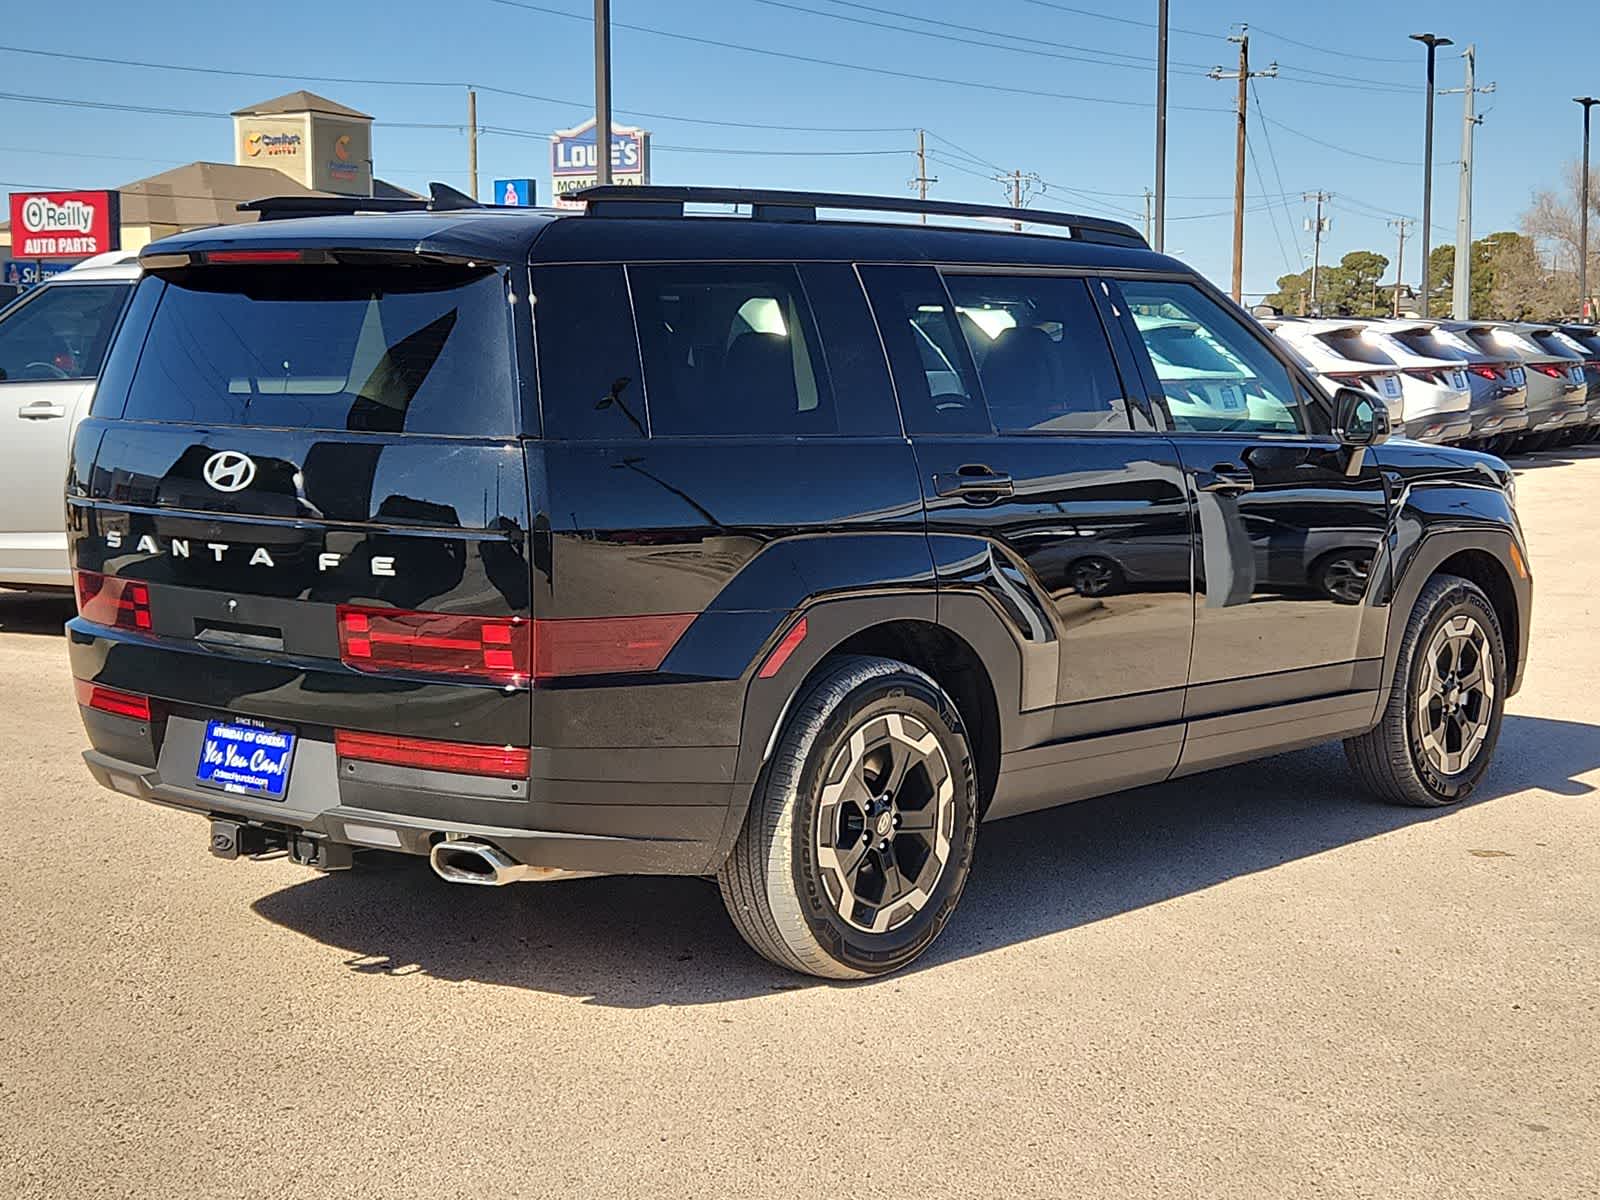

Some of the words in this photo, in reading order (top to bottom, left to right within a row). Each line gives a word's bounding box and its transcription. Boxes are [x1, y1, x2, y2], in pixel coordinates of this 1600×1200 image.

[24, 200, 92, 231] O'Reilly
[24, 238, 56, 254] AUTO
[57, 237, 97, 253] PARTS
[105, 529, 276, 568] SANTA
[319, 552, 397, 577] FE
[204, 740, 223, 765] Yes
[224, 743, 248, 768] You
[250, 748, 287, 776] Can!
